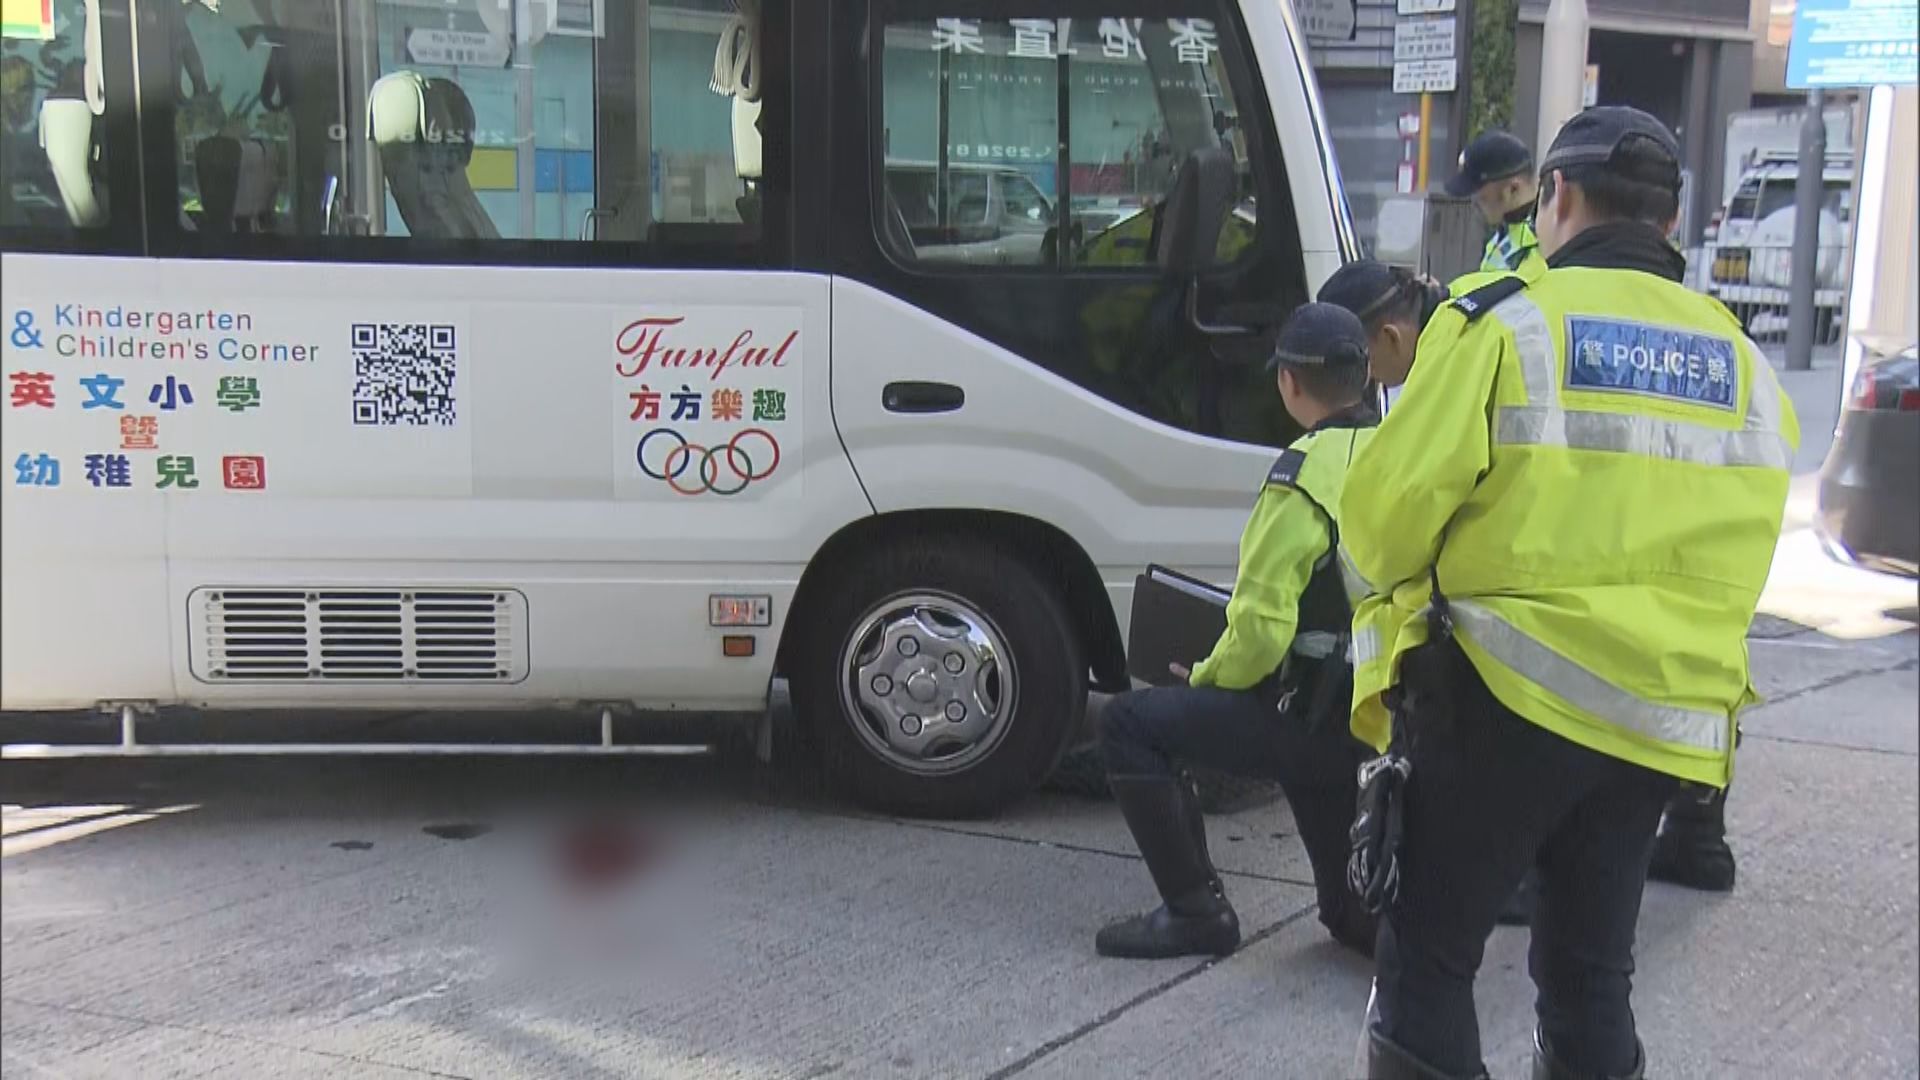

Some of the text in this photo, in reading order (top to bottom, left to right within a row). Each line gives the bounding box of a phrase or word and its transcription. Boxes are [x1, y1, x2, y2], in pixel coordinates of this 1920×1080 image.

[10, 310, 42, 349] &
[55, 304, 251, 335] Kindergarten
[56, 334, 320, 362] Children's Corner
[615, 317, 799, 380] Funful
[1582, 340, 1731, 385] 警 POLICE 察
[9, 371, 262, 412] 英文小學
[629, 384, 786, 421] 方方樂趣
[119, 415, 158, 450] 暨
[14, 453, 267, 490] 幼稚兒園
